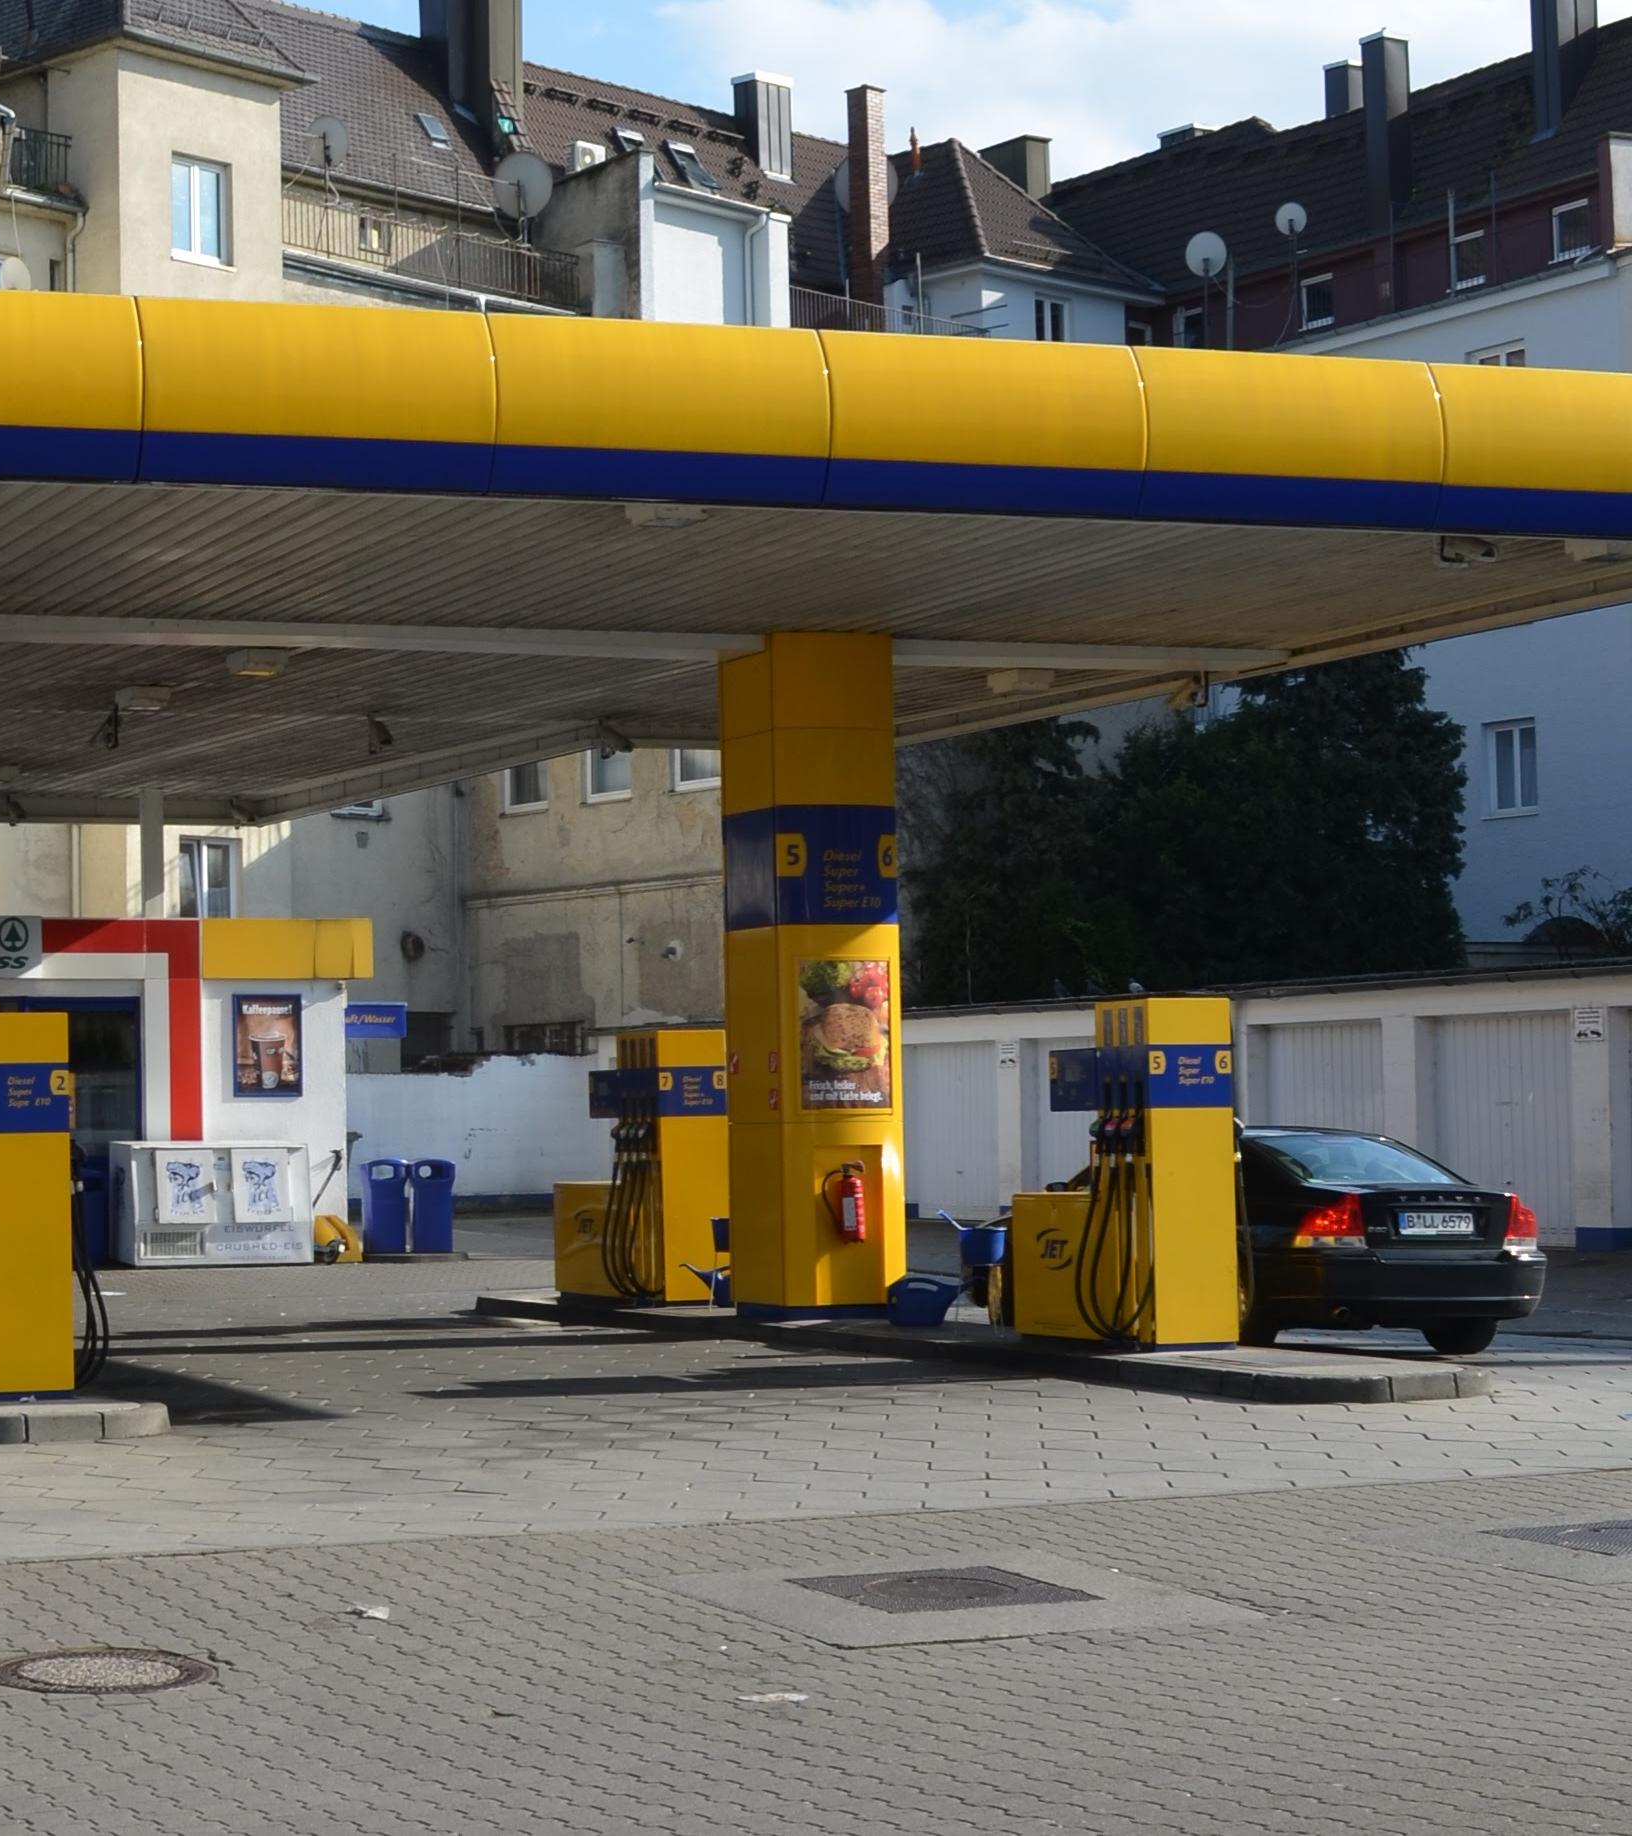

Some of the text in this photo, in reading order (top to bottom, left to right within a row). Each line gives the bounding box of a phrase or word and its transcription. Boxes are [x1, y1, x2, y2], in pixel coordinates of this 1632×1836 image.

[786, 844, 800, 866] 5
[824, 849, 862, 861] Diesel
[882, 845, 893, 867] 6
[824, 865, 859, 880] Super
[824, 896, 859, 910] Super
[1153, 1056, 1161, 1070] 5
[1178, 1056, 1202, 1065] Diesel
[1219, 1056, 1227, 1069] 6
[1178, 1066, 1200, 1077] Super
[7, 1076, 36, 1086] Diesel
[56, 1075, 65, 1090] 2
[661, 1076, 669, 1088] 7
[716, 1074, 724, 1087] 8
[1178, 1076, 1201, 1086] Super
[1407, 1215, 1415, 1229] B
[1442, 1215, 1471, 1229] 6579
[1040, 1239, 1069, 1259] JET
